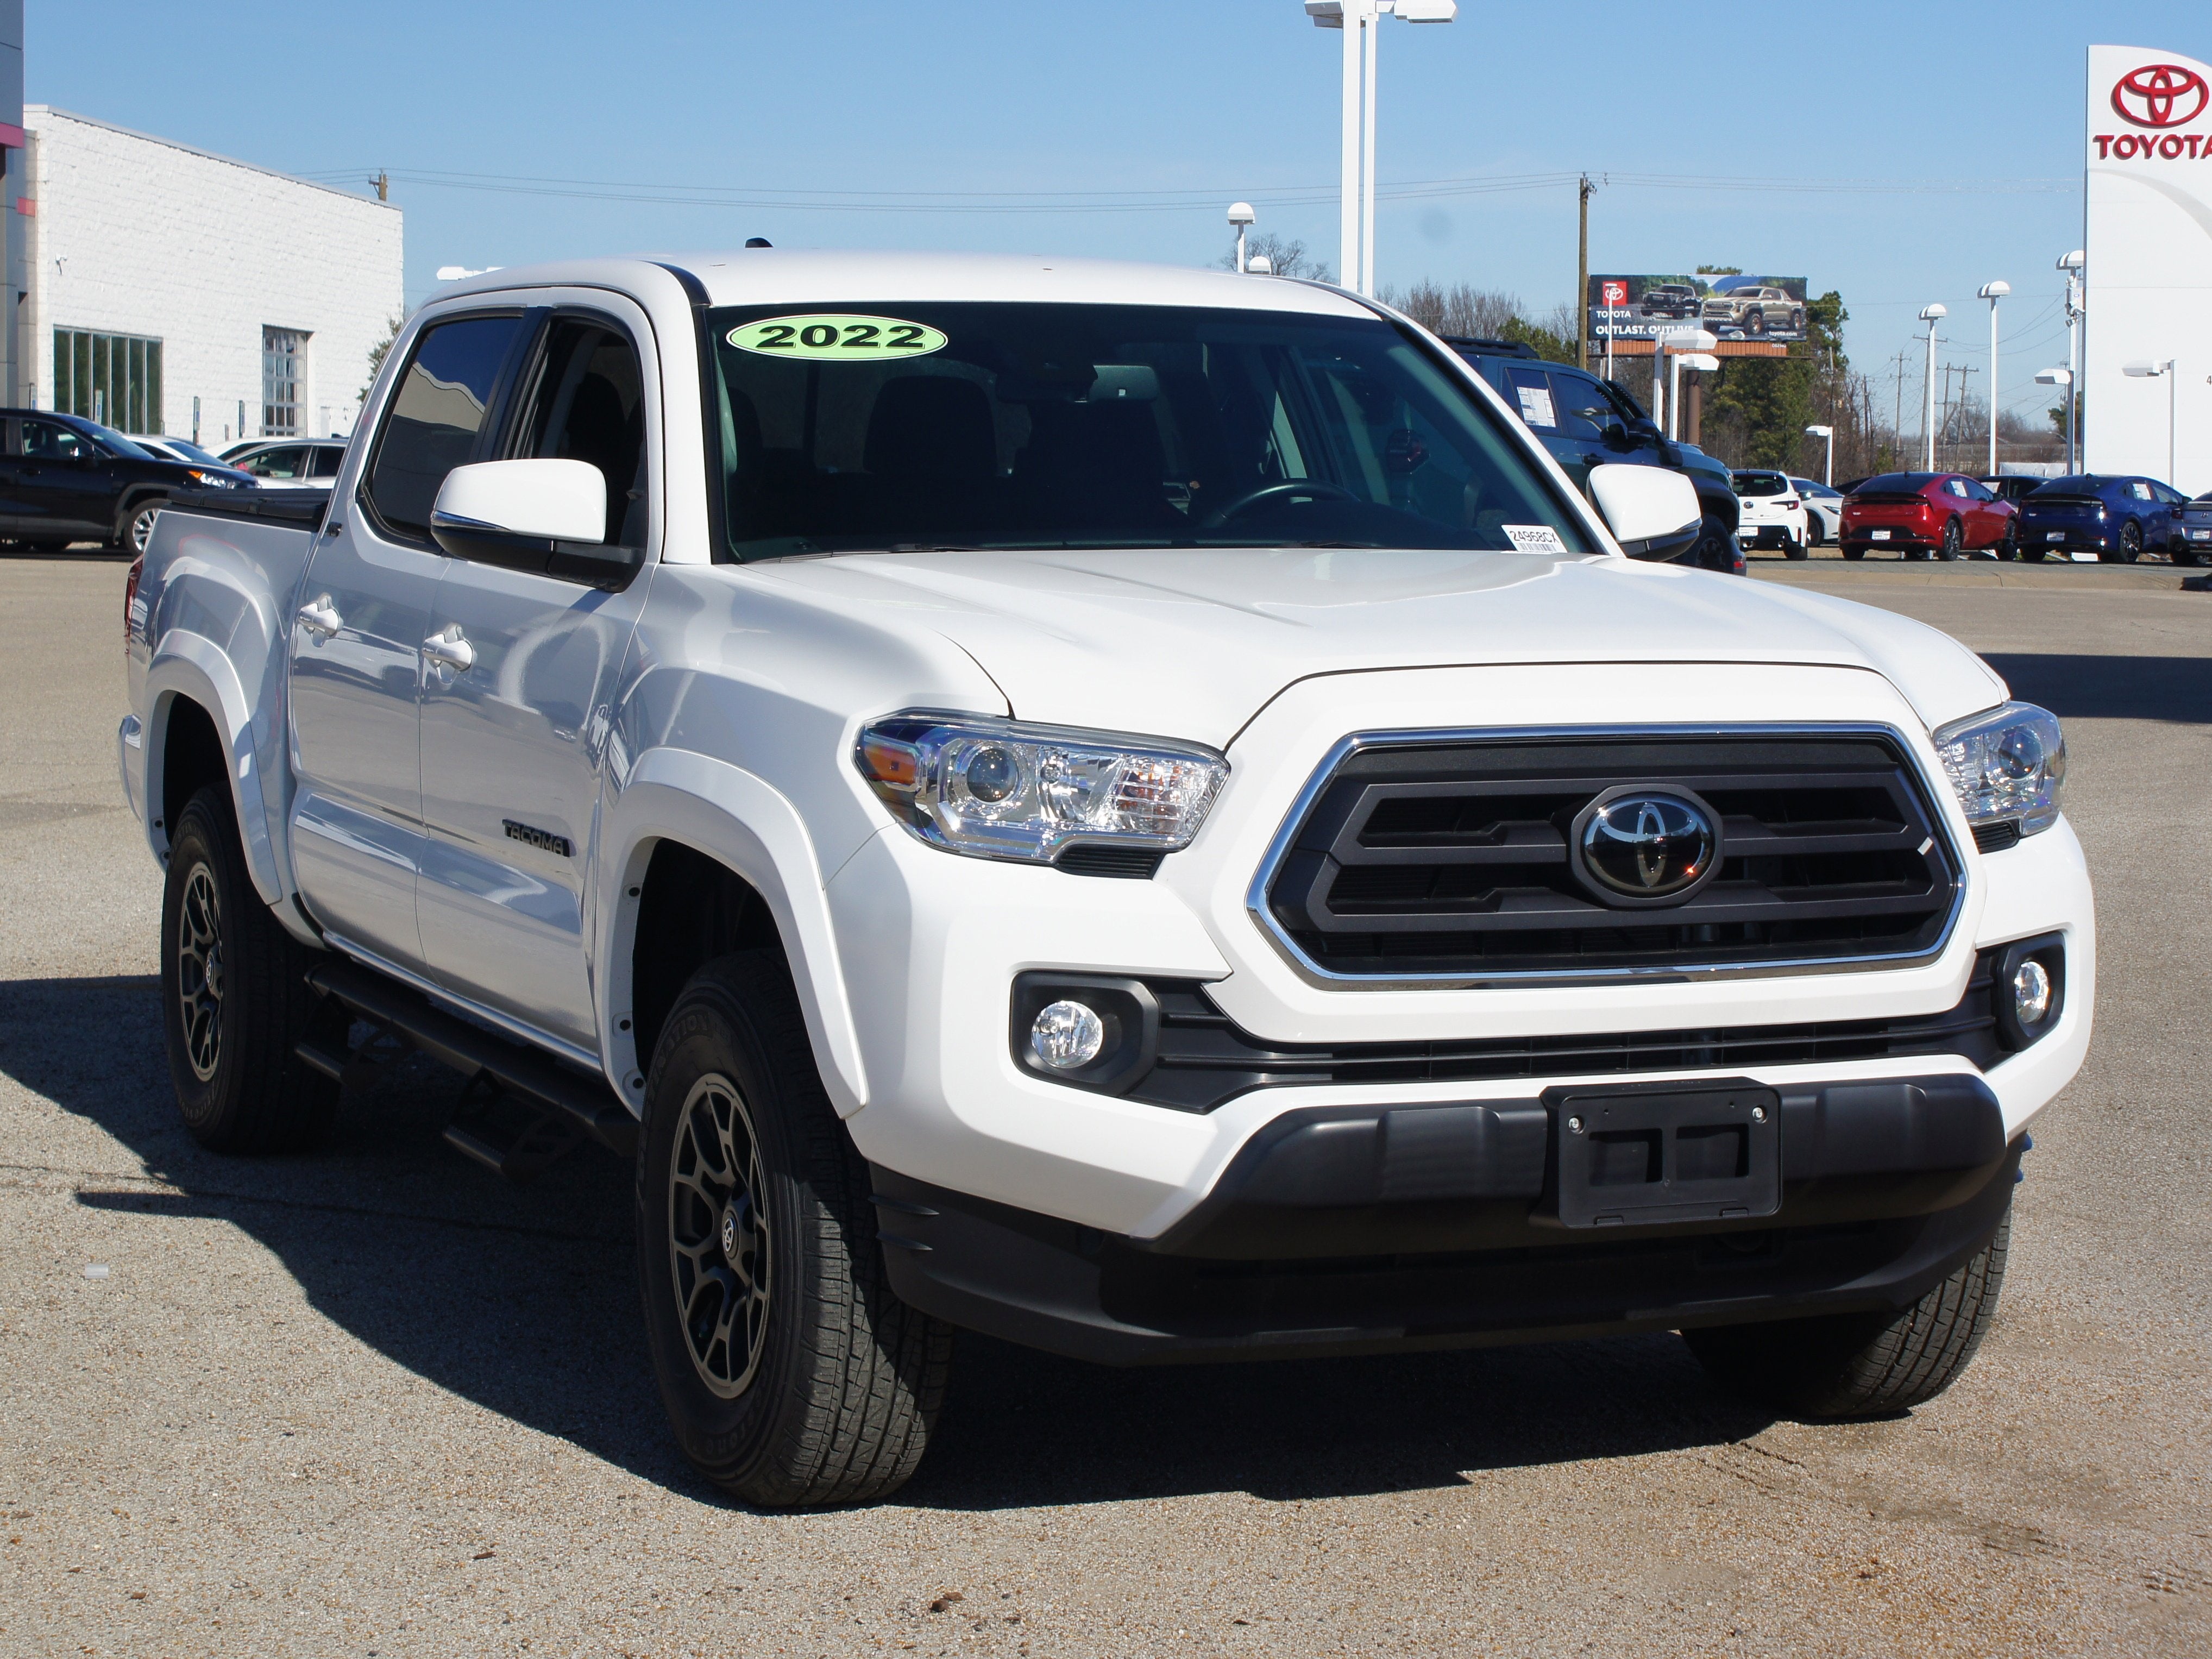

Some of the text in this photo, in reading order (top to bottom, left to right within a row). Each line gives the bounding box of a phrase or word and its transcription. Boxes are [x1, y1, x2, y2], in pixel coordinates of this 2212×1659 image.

[1596, 310, 1631, 318] TOOTA
[756, 325, 926, 349] 2022
[1510, 530, 1559, 543] 24968CX
[502, 819, 569, 857] TACOMA
